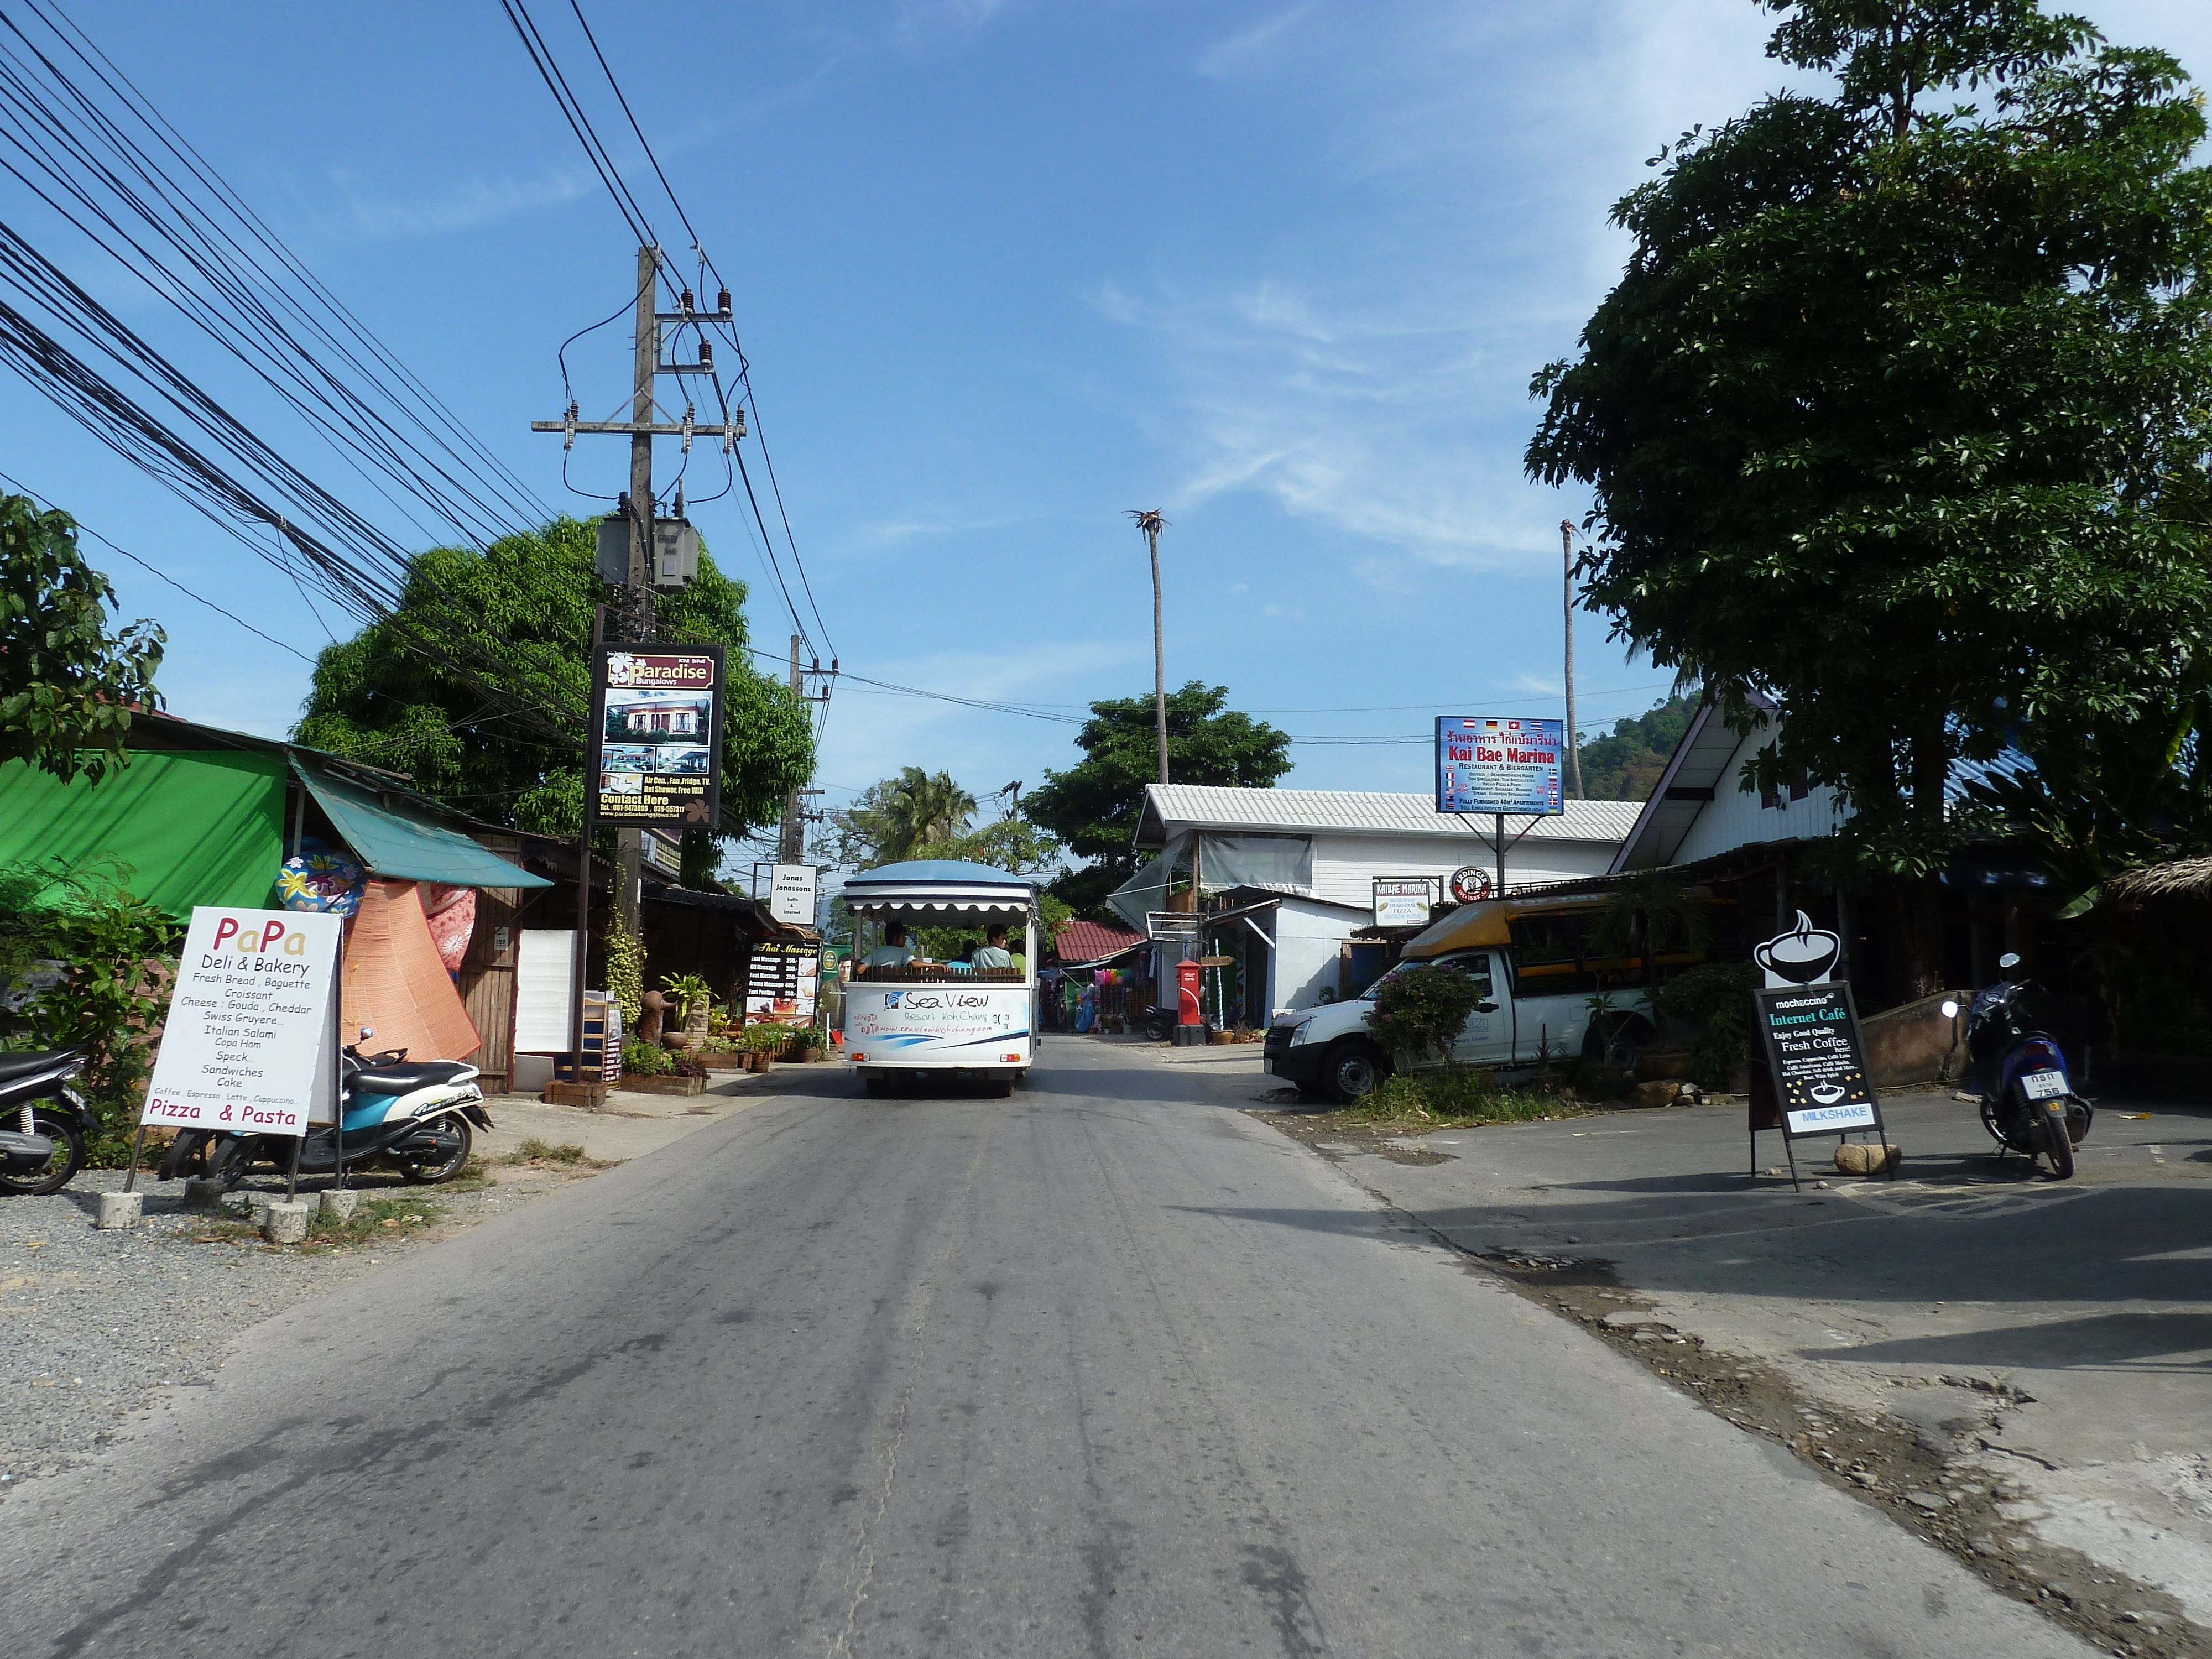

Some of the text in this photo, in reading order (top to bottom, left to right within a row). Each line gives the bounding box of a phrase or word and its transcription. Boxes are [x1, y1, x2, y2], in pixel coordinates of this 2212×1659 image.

[629, 664, 707, 684] Paradise
[636, 677, 677, 686] Bungalows
[1447, 730, 1496, 744] ร้านอาหาร
[1449, 745, 1555, 764] Kai Bae Marina
[601, 794, 669, 805] Contact Here
[1457, 870, 1488, 884] ERDINGER
[1376, 883, 1427, 895] KAIBAE MARINA
[212, 917, 307, 956] PaPa
[759, 943, 817, 957] Thai Massage
[201, 954, 310, 978] Deli & Bakery
[193, 972, 311, 990] Fresh Bread Baguette
[225, 989, 273, 1000] Croissant
[904, 992, 989, 1010] Sea View
[181, 997, 312, 1014] Cheese Gouda Cheddar
[1776, 997, 1827, 1009] mochaccino
[203, 1011, 232, 1021] Swiss
[905, 1010, 987, 1023] Resort Koh Chang
[1768, 1008, 1846, 1026] Internet Café
[204, 1025, 277, 1039] Italian Salami
[1793, 1029, 1811, 1037] Good
[1812, 1027, 1835, 1036] Quality
[215, 1037, 261, 1049] Copa Ham
[1781, 1037, 1848, 1052] Fresh Coffee
[201, 1065, 264, 1077] Sandwiches
[217, 1077, 243, 1088] Cake
[154, 1087, 181, 1096] Coffee
[187, 1089, 220, 1099] Espresso
[2036, 1087, 2060, 1097] 756
[149, 1098, 296, 1125] Pizza & Pasta
[1802, 1107, 1867, 1122] MILKSHAKE
